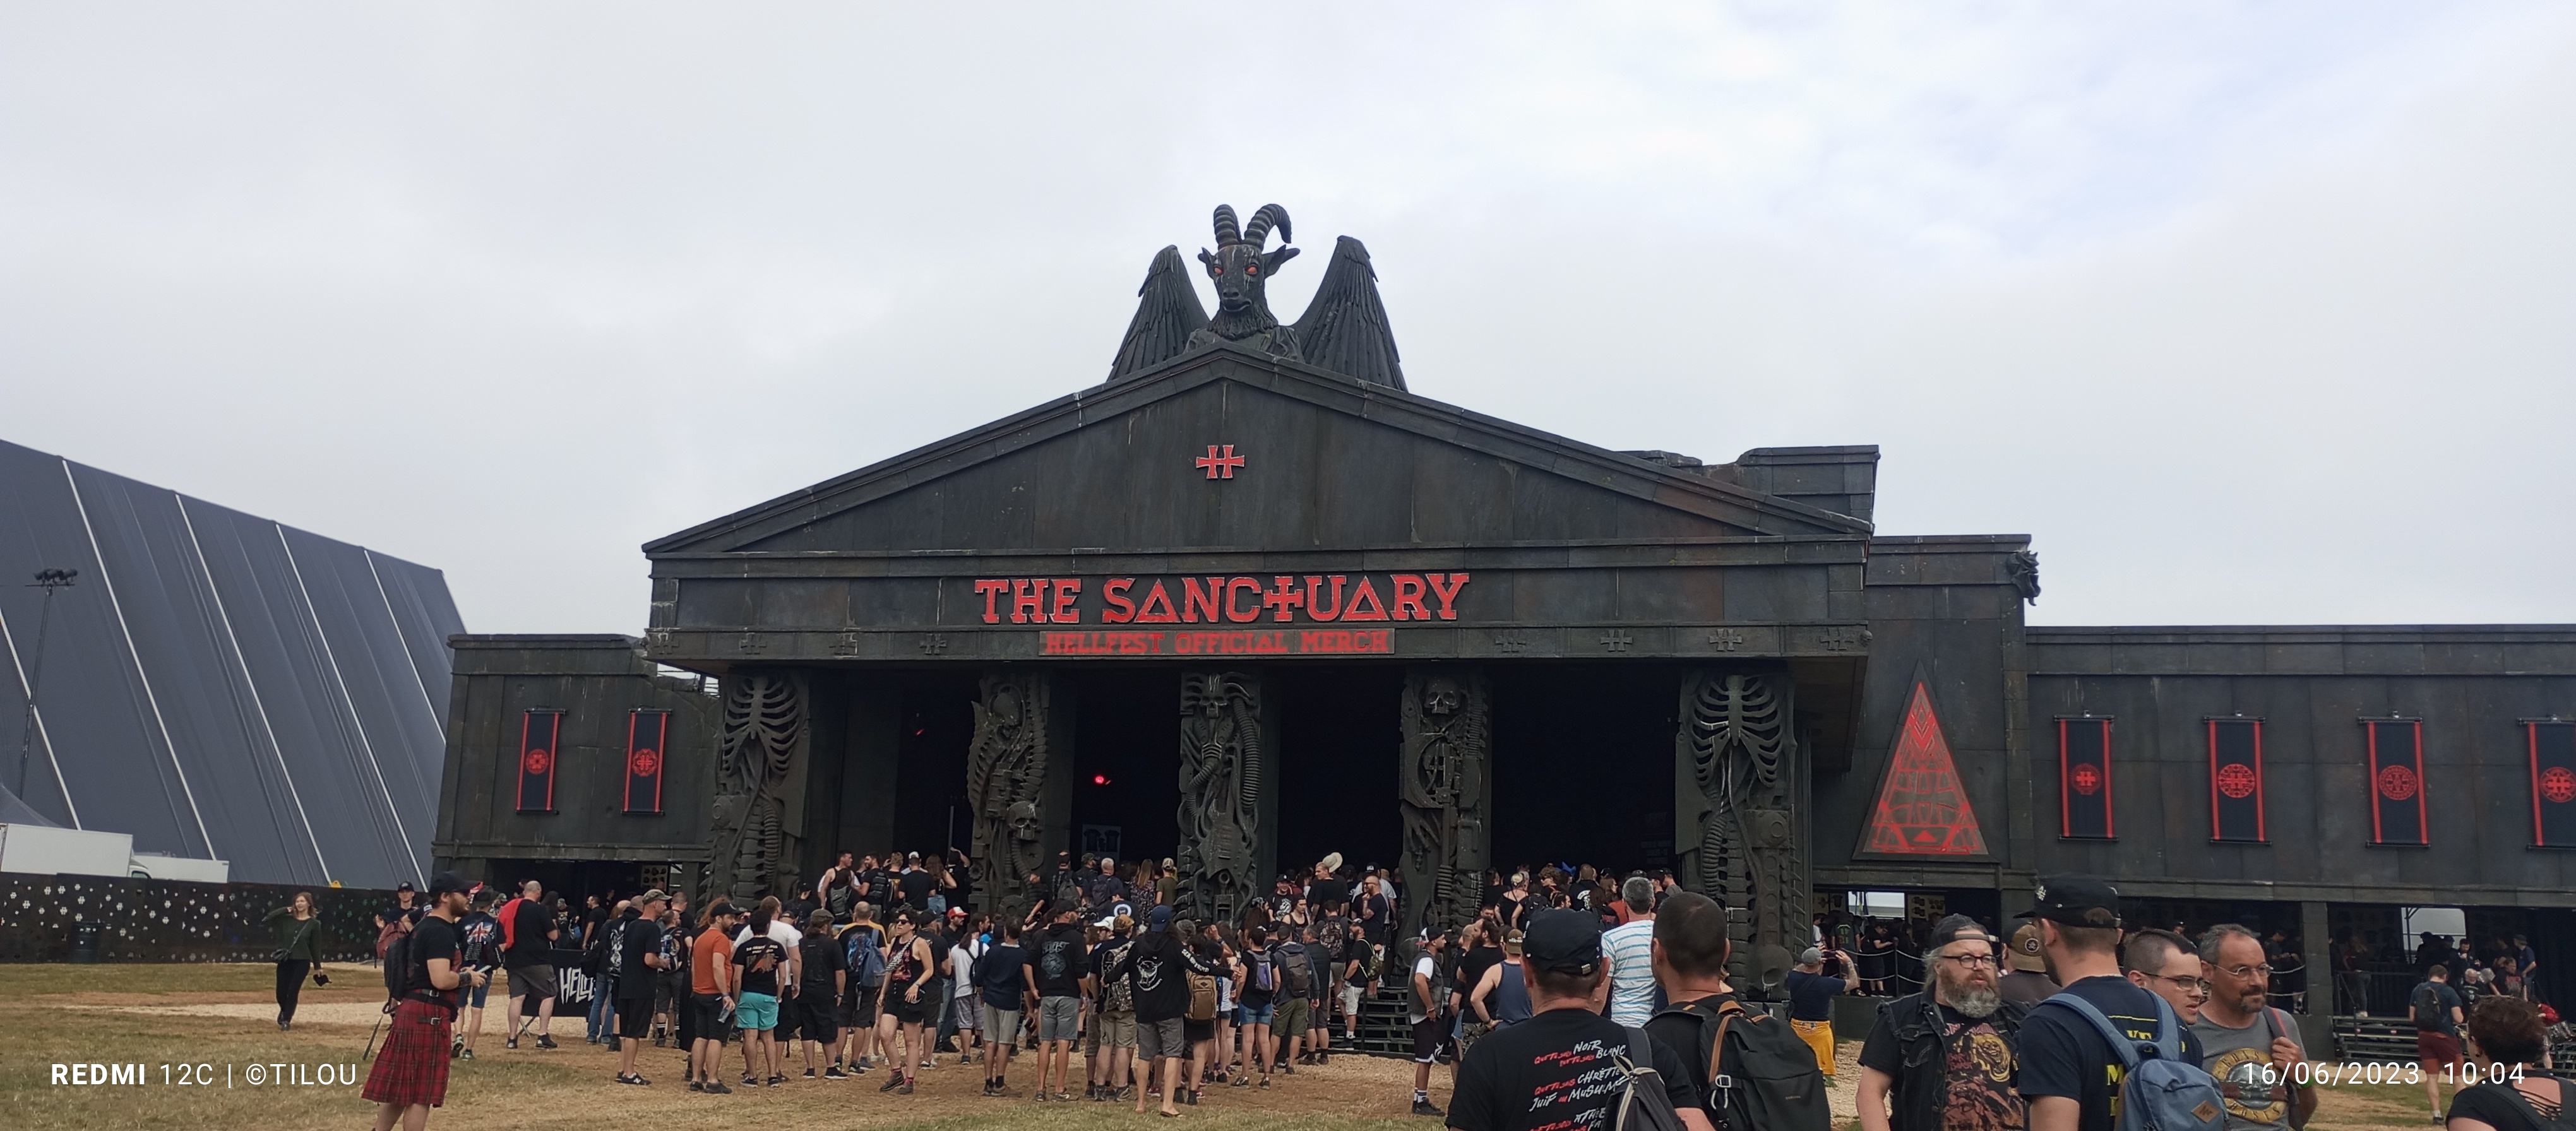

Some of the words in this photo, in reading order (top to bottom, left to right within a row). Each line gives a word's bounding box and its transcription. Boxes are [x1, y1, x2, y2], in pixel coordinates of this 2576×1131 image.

[975, 577, 1082, 624] THE
[1046, 632, 1164, 654] HELLFEST
[1175, 632, 1288, 654] OFFICIAL
[1299, 631, 1389, 653] MERCH
